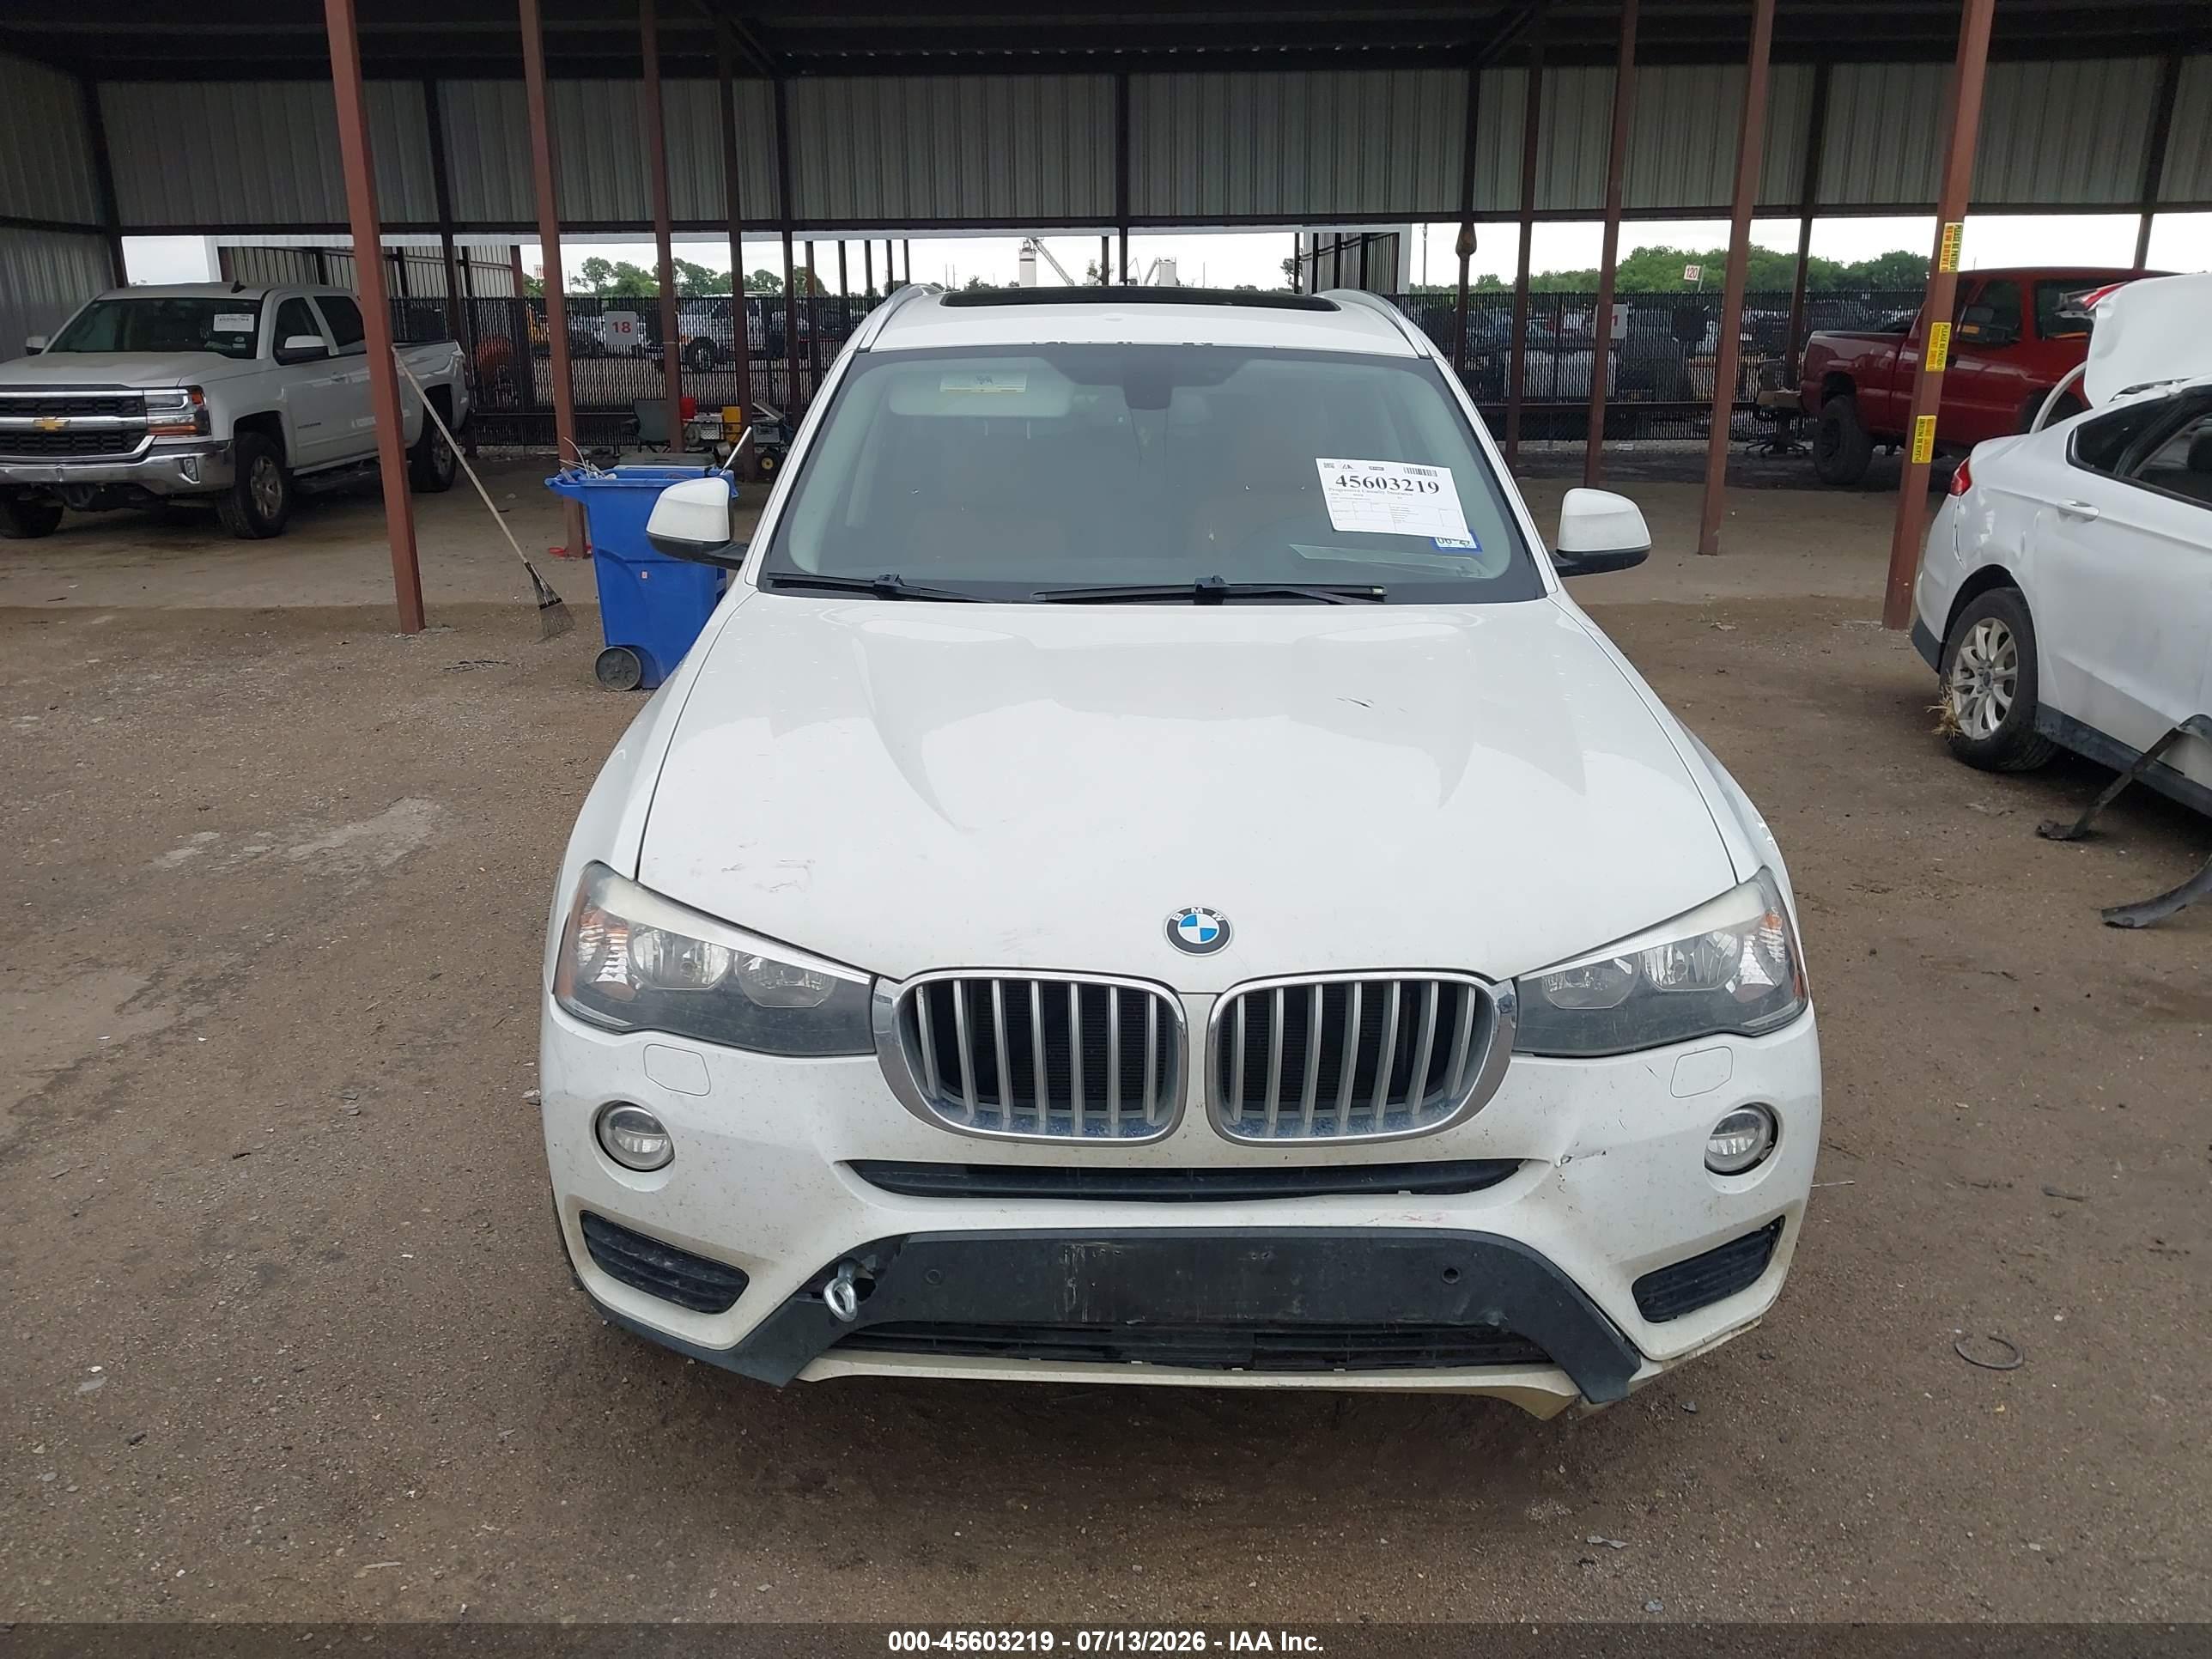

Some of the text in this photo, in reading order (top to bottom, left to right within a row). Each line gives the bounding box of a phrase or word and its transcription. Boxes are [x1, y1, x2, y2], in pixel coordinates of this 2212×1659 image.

[1686, 267, 1698, 279] 120
[611, 321, 632, 334] 18
[1335, 474, 1440, 495] 45603219
[1170, 907, 1224, 921] BMW
